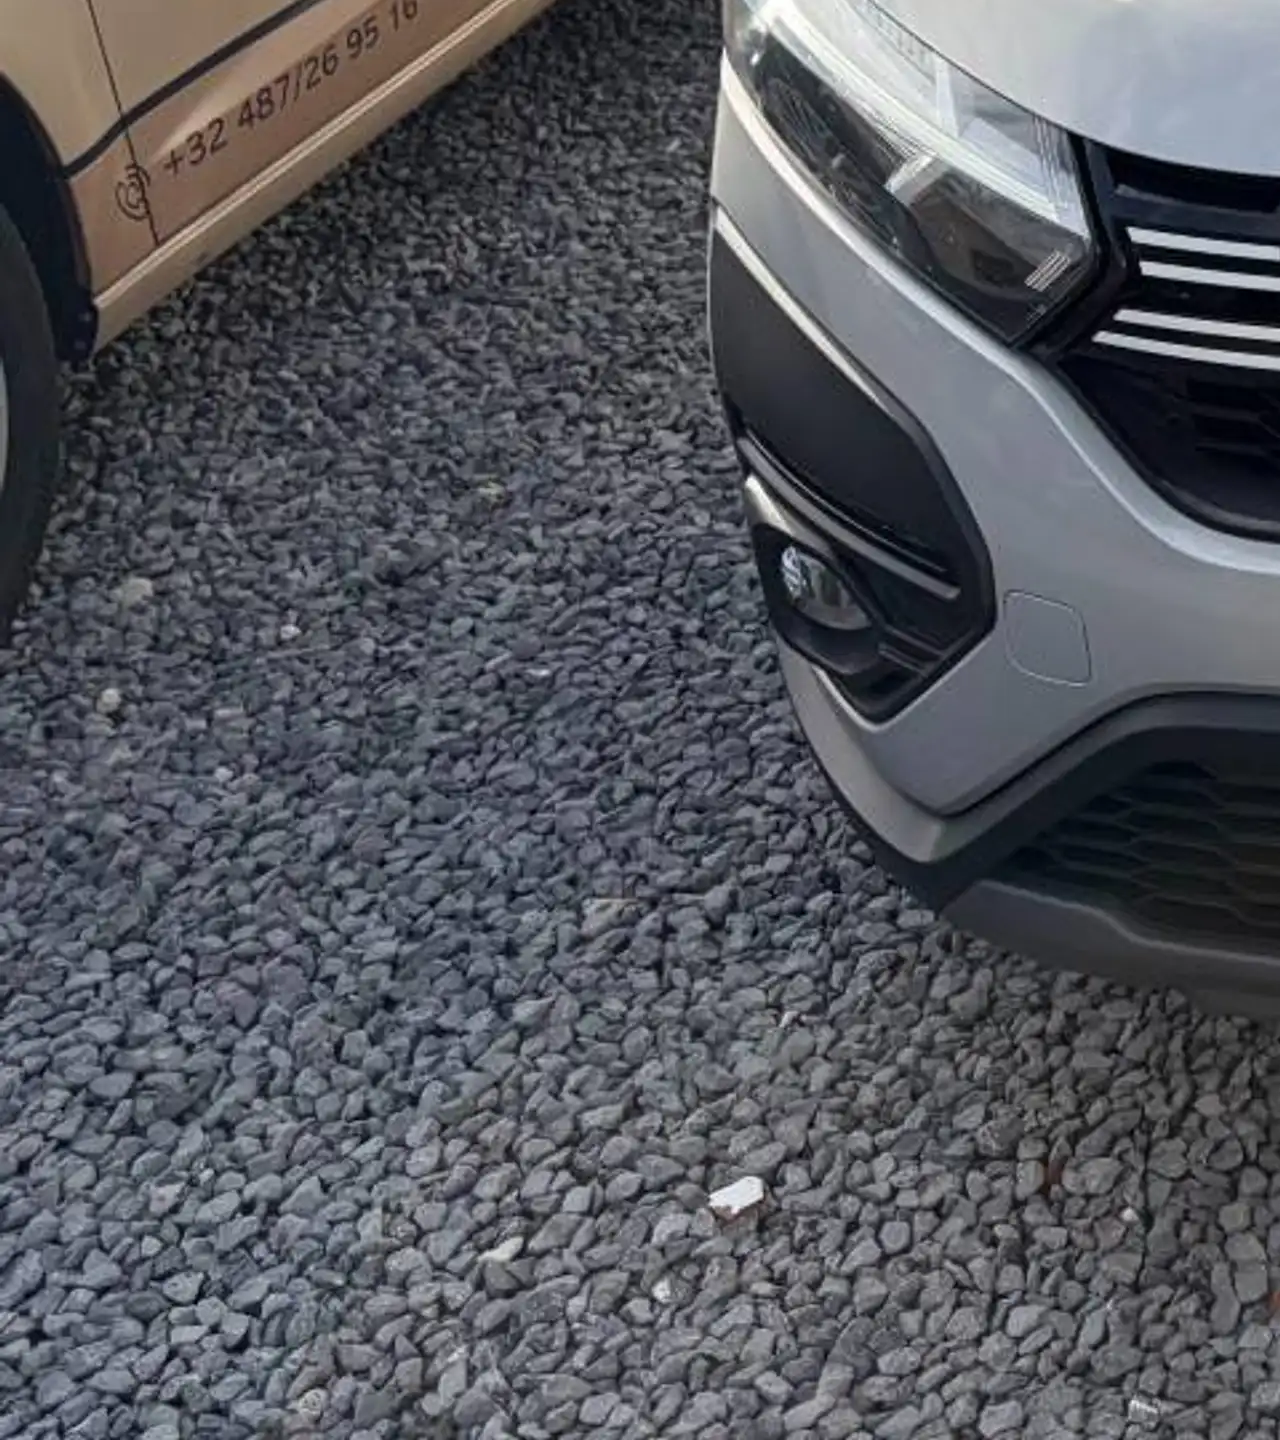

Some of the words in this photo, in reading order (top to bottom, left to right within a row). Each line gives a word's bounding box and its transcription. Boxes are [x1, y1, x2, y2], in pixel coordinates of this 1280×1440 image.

[164, 117, 228, 178] +32
[237, 44, 339, 130] 487/26
[346, 16, 379, 58] 95
